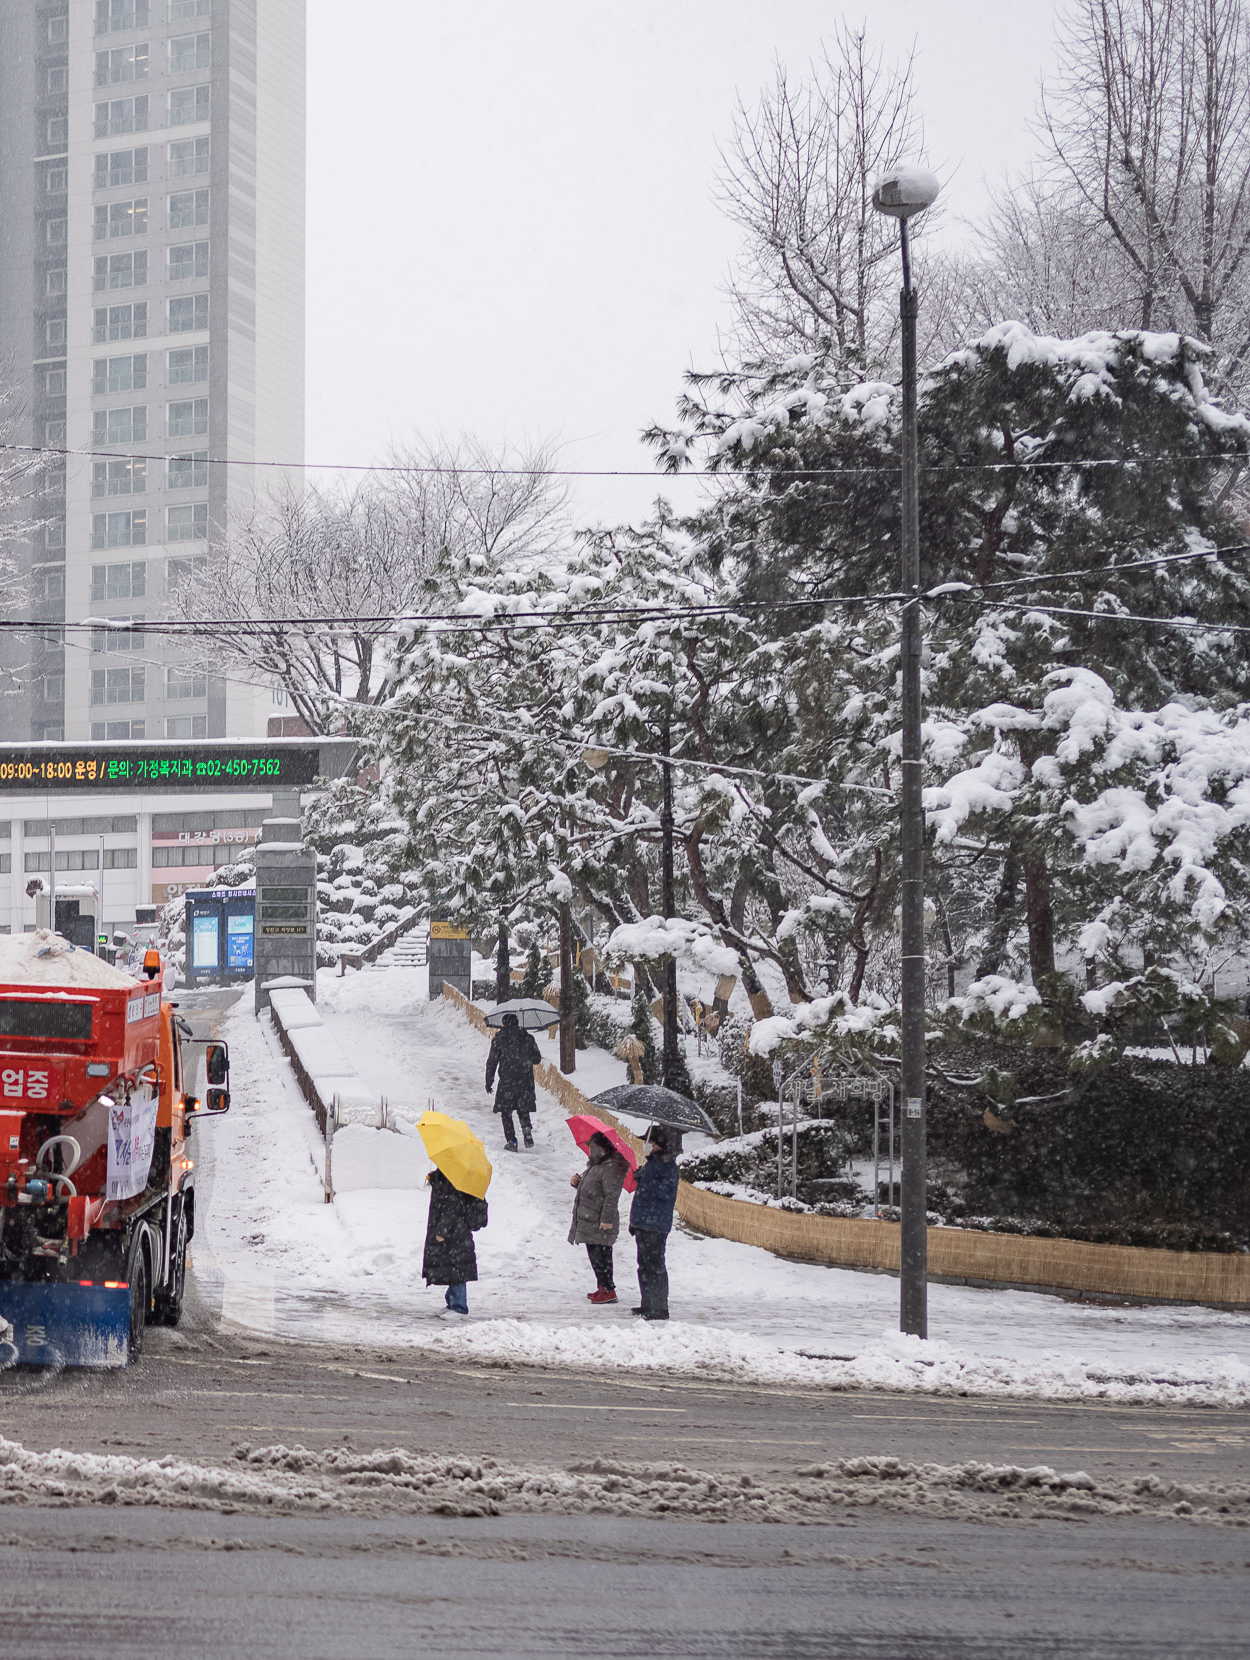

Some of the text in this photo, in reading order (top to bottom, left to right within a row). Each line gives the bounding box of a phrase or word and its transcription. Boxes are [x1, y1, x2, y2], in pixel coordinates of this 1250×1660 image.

[0, 761, 73, 779] 09:00~18:00
[74, 760, 98, 780] 운영
[107, 760, 134, 779] 문의:
[136, 759, 193, 779] 가정복지과
[25, 1324, 47, 1347] 중
